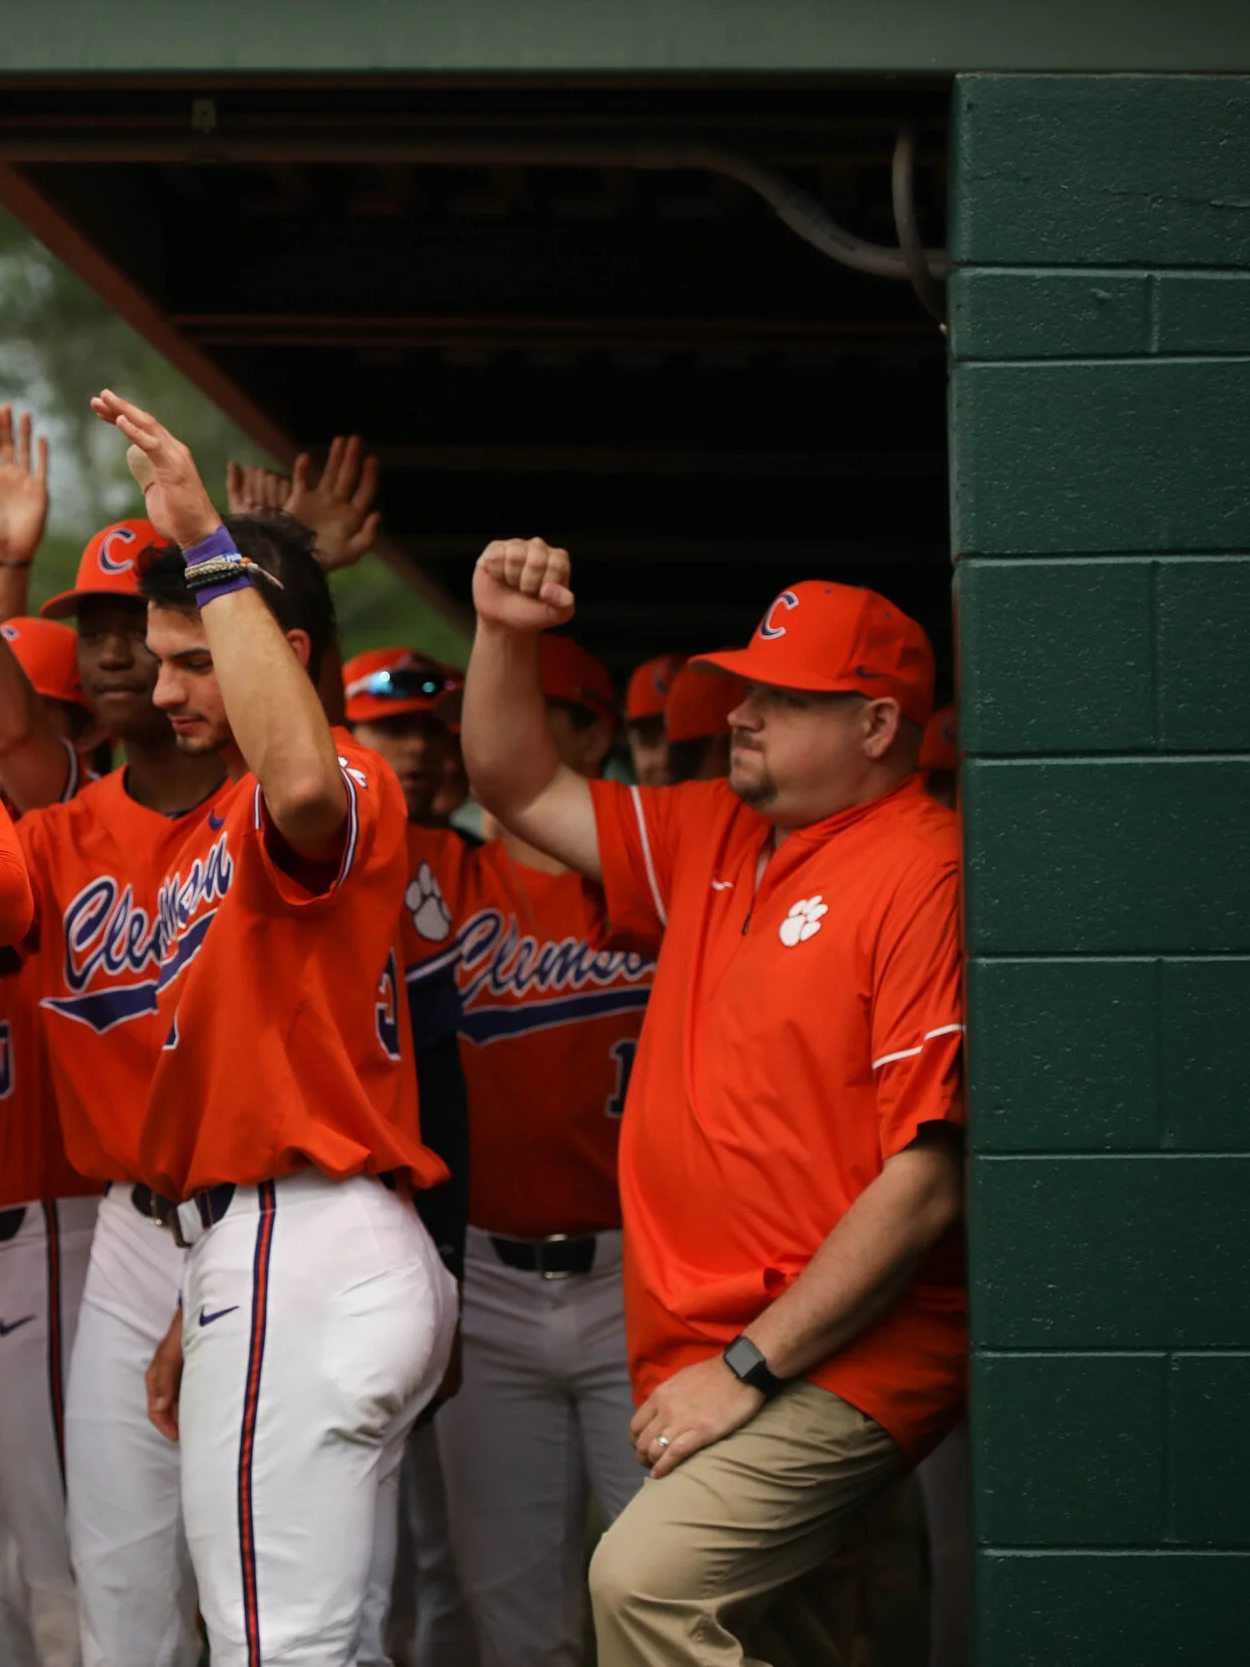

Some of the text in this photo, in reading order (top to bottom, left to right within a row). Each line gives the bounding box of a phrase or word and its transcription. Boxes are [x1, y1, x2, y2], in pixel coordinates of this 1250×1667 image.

[97, 527, 137, 575] C
[759, 590, 799, 640] C
[453, 907, 658, 1008] Clemso
